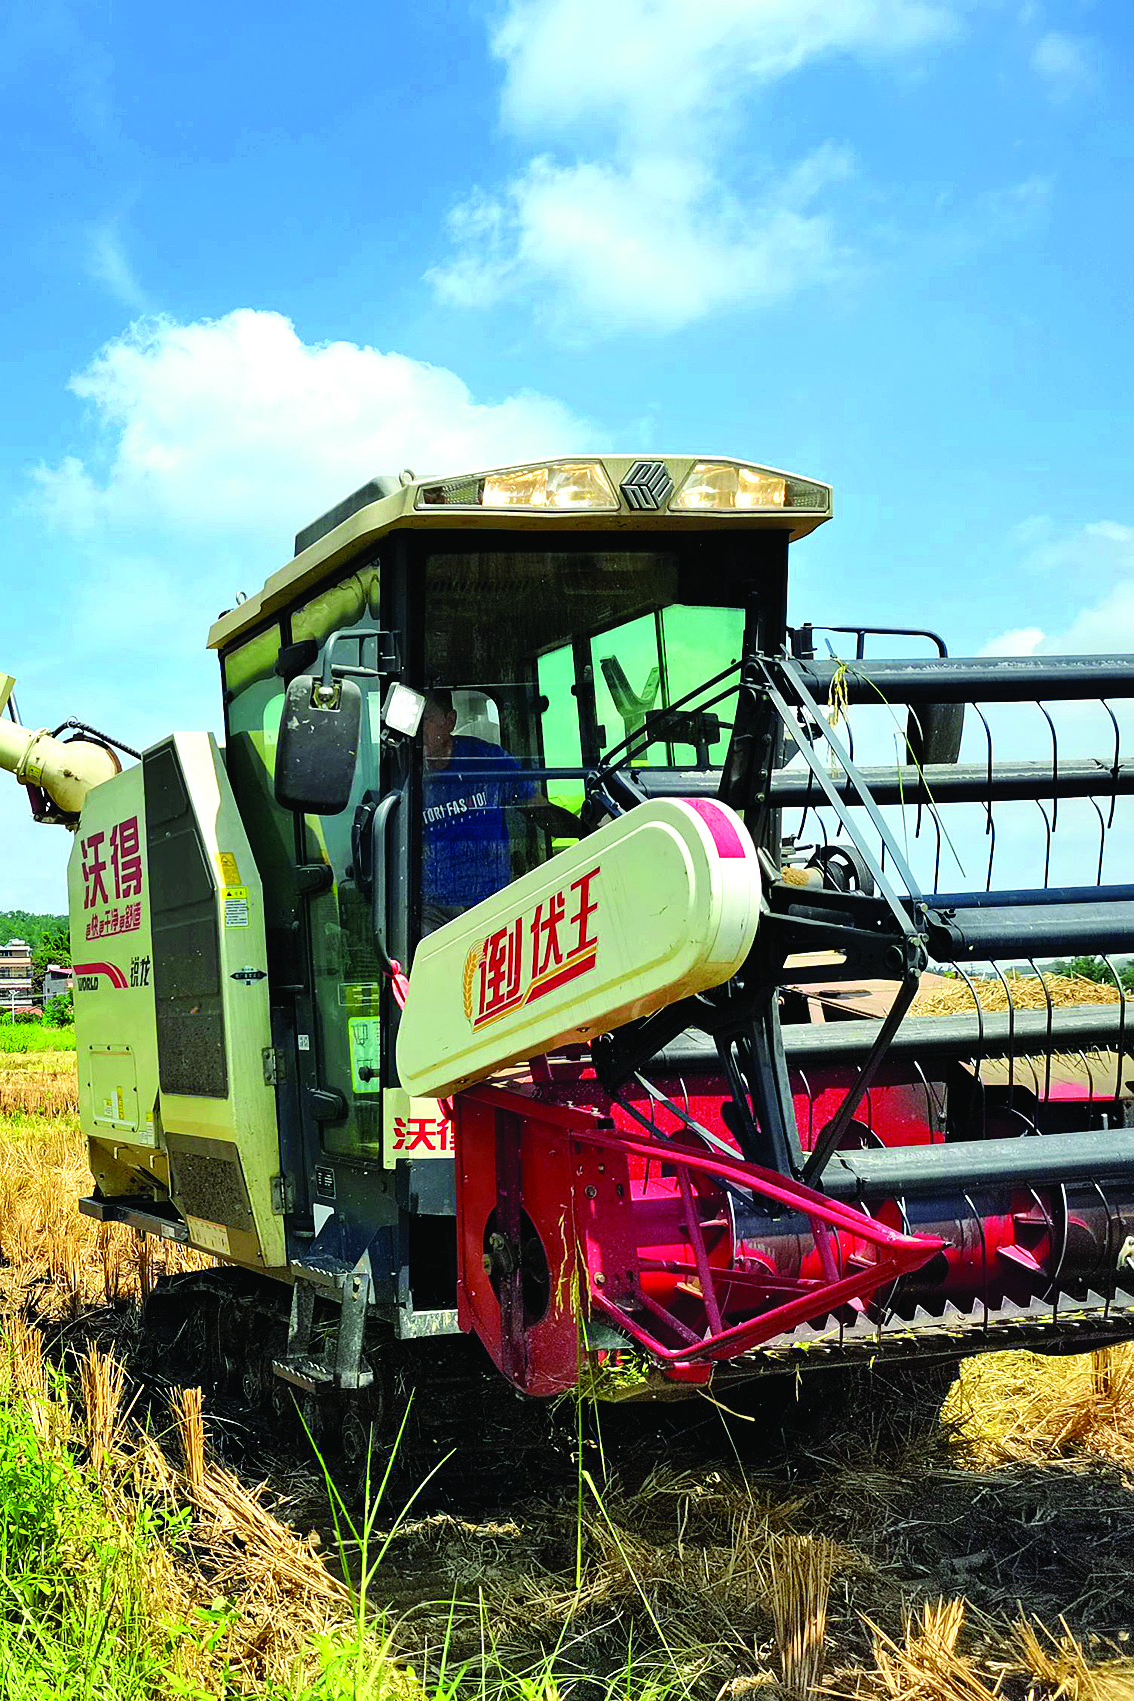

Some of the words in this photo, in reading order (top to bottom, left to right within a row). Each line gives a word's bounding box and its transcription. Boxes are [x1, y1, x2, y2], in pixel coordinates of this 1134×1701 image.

[81, 816, 142, 909] 沃得
[130, 955, 150, 987] 锐龙
[479, 866, 600, 1015] 倒伏王
[78, 977, 98, 991] WORLD
